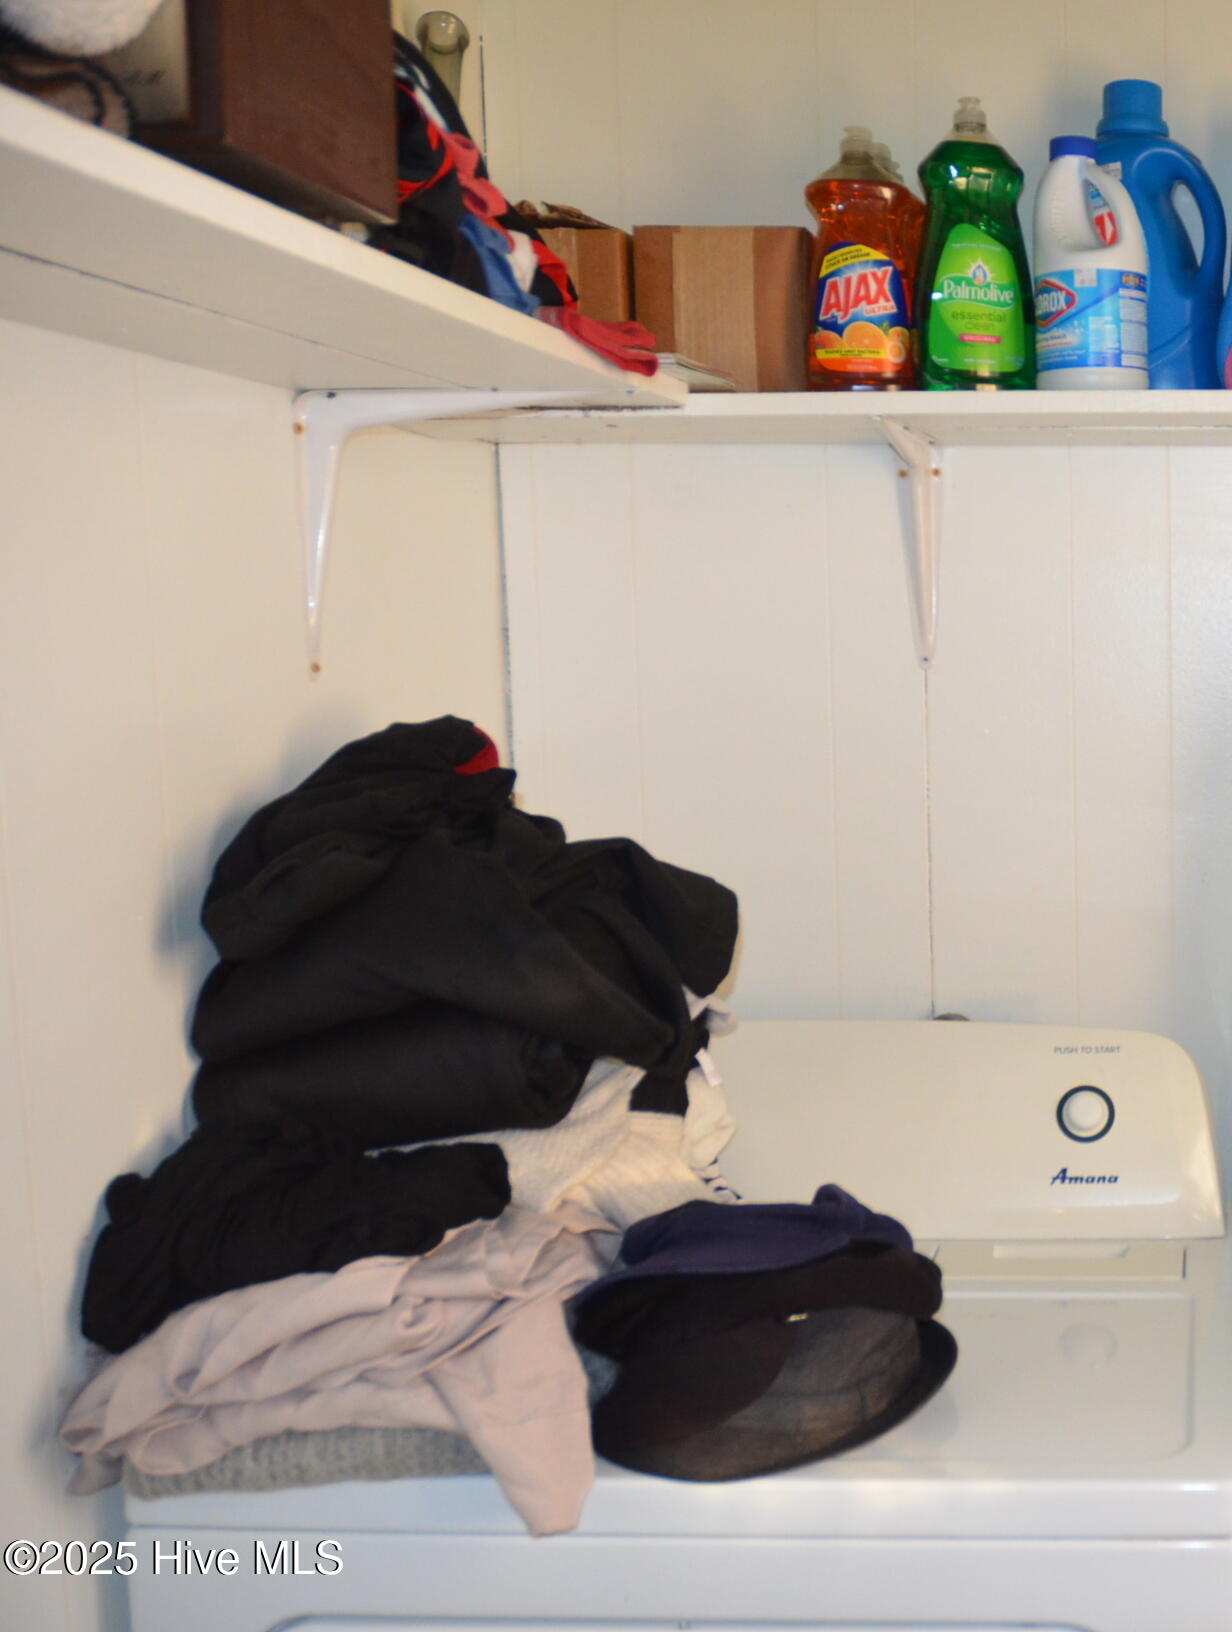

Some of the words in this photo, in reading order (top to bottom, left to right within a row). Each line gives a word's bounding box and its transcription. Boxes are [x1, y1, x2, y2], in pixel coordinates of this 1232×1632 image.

[820, 266, 894, 322] AJAX
[943, 278, 1014, 303] Palmolive
[951, 310, 1007, 322] essential
[1053, 1046, 1079, 1055] PUSH
[1081, 1046, 1093, 1054] TO
[1095, 1046, 1121, 1054] START
[1050, 1167, 1119, 1186] Amana
